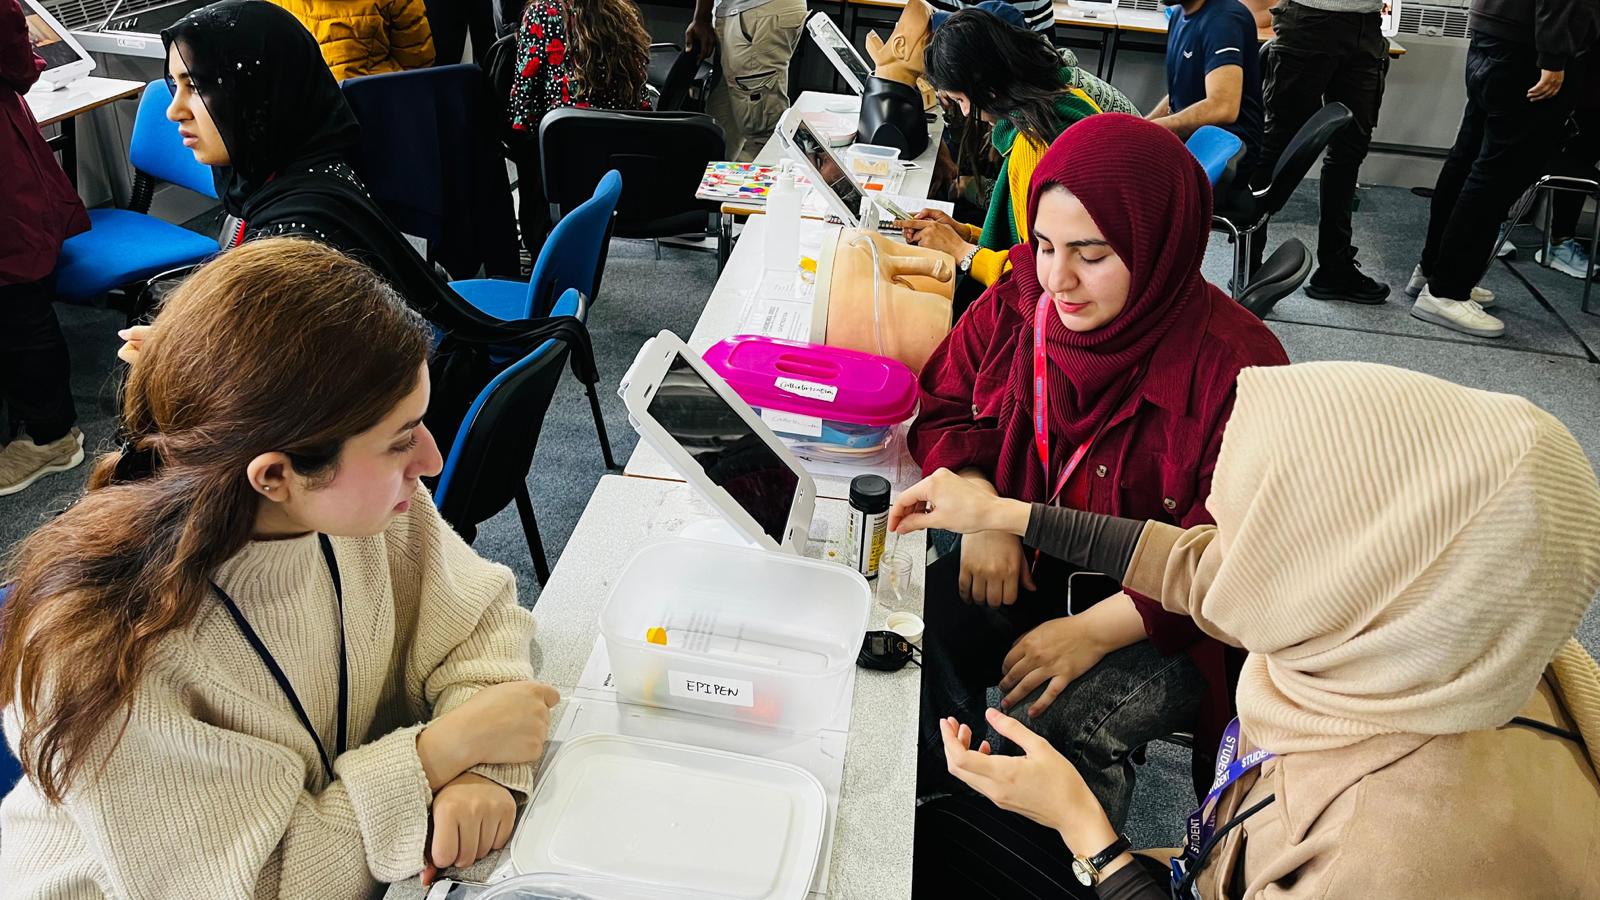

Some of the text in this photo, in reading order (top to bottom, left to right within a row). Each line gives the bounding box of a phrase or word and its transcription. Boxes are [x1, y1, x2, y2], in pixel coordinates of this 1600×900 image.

[686, 679, 739, 697] EPIPEN
[1216, 735, 1236, 777] STUDEN
[1241, 749, 1271, 768] STUDE
